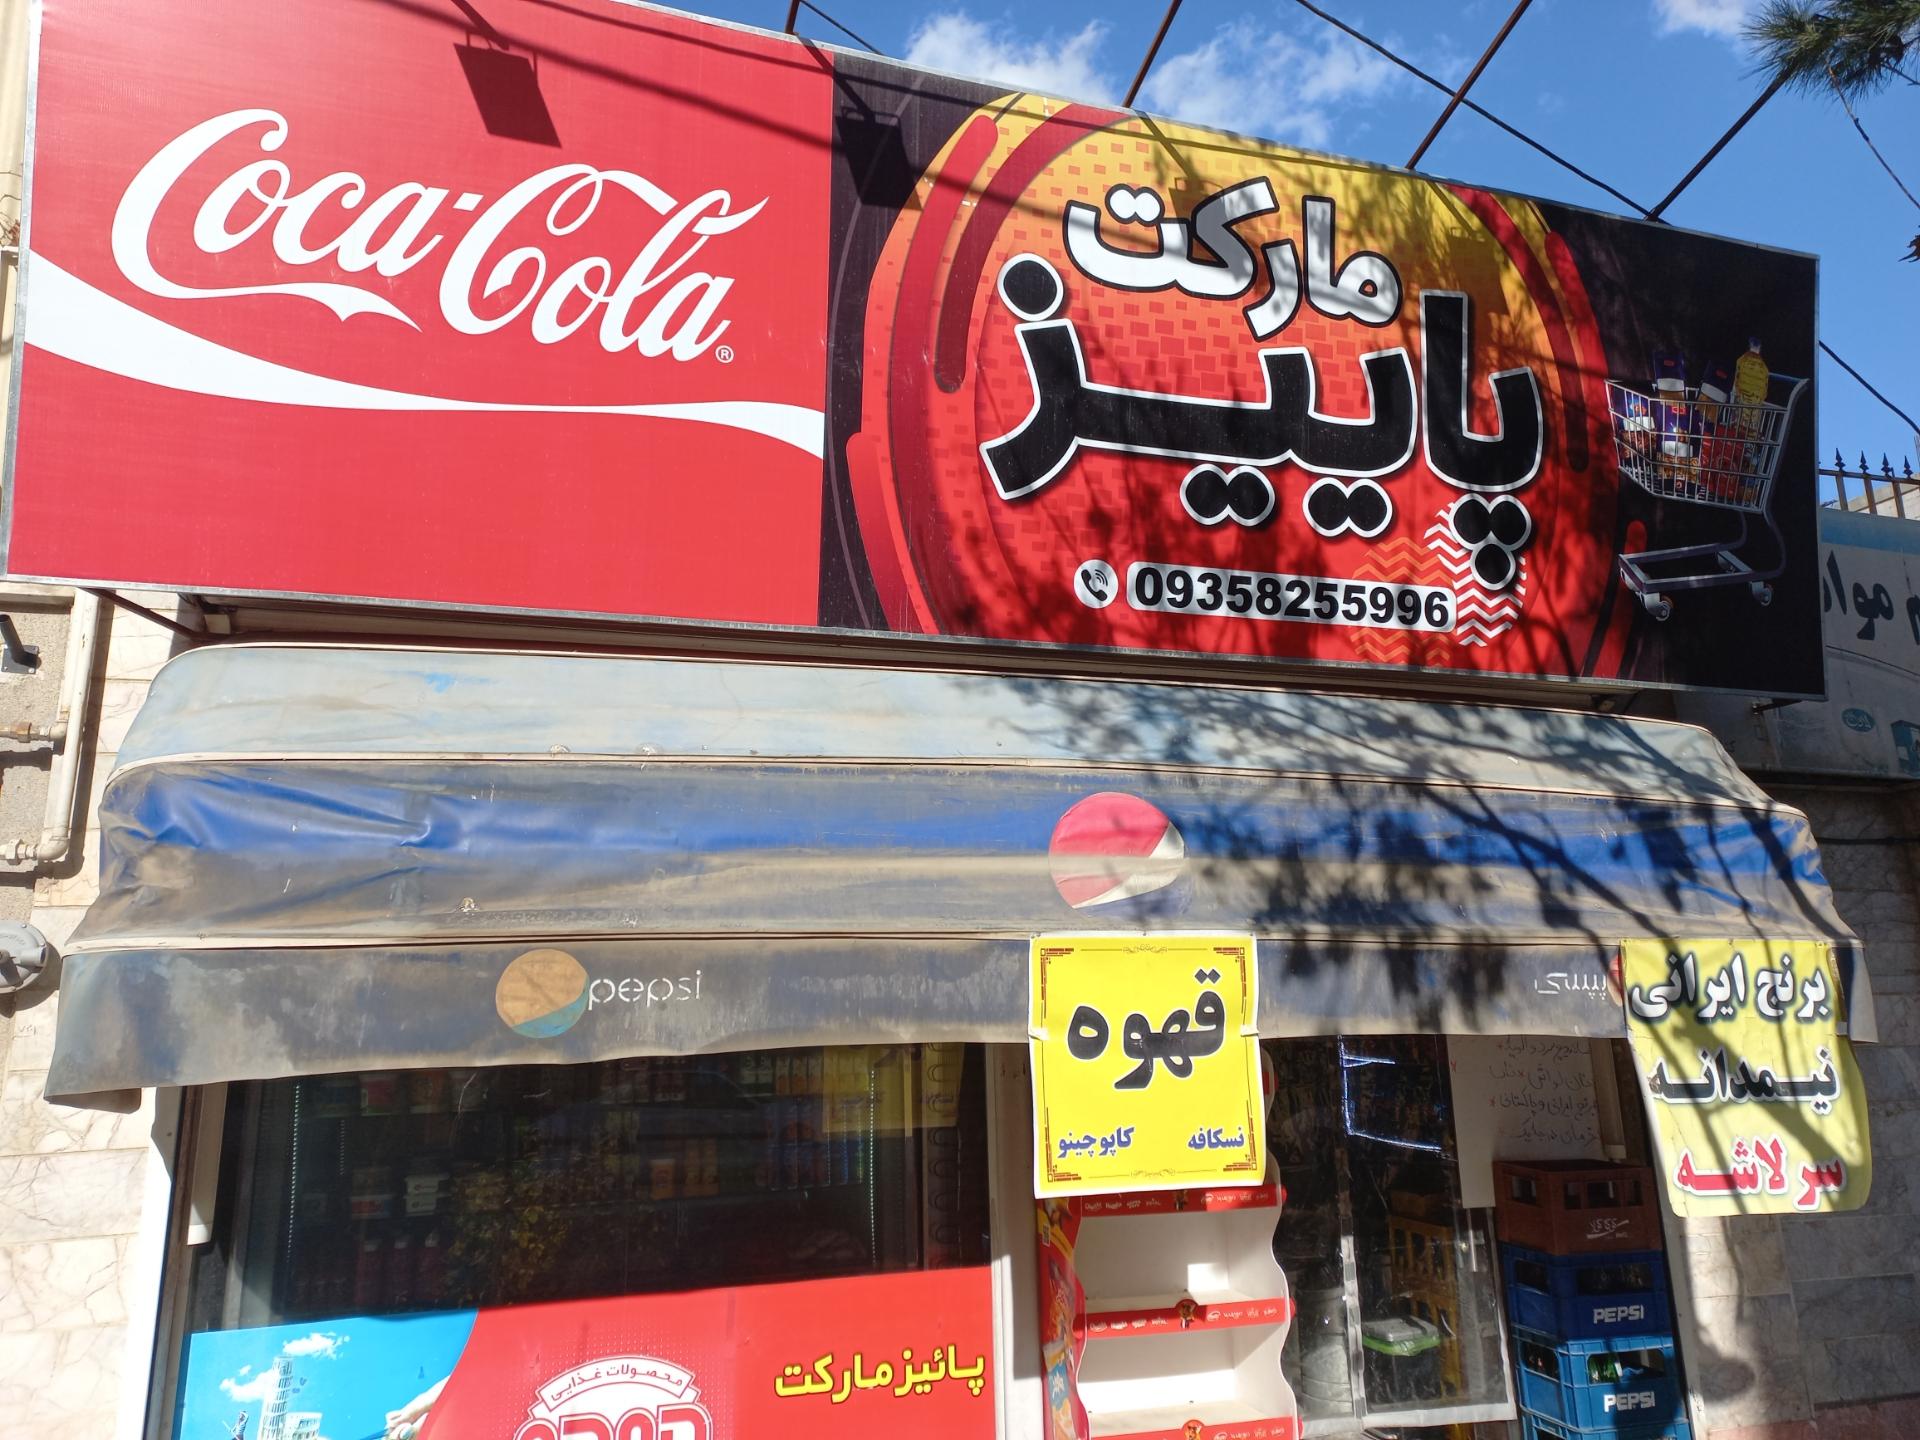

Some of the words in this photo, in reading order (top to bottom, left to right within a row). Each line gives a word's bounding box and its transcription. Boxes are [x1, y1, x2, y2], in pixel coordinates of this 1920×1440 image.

[111, 108, 769, 363] Coca-Cola
[1064, 177, 1402, 341] مارکت
[979, 252, 1543, 591] پاییز
[1135, 566, 1449, 627] 09358255996
[588, 970, 702, 1011] pepsi
[1534, 972, 1606, 1001] پپسی
[1630, 952, 1745, 1020] ایرانی
[1755, 953, 1831, 1020] برنج
[1067, 967, 1226, 1090] قهوه
[1650, 1047, 1840, 1115] نیمدانه
[1187, 1126, 1245, 1151] نسکافه
[1593, 1304, 1645, 1324] PEPSI
[550, 1367, 602, 1402] غذایی
[605, 1363, 683, 1387] محصولات
[774, 1352, 894, 1404] مارکت
[894, 1344, 986, 1397] پائیز
[1603, 1391, 1655, 1412] PEPSI
